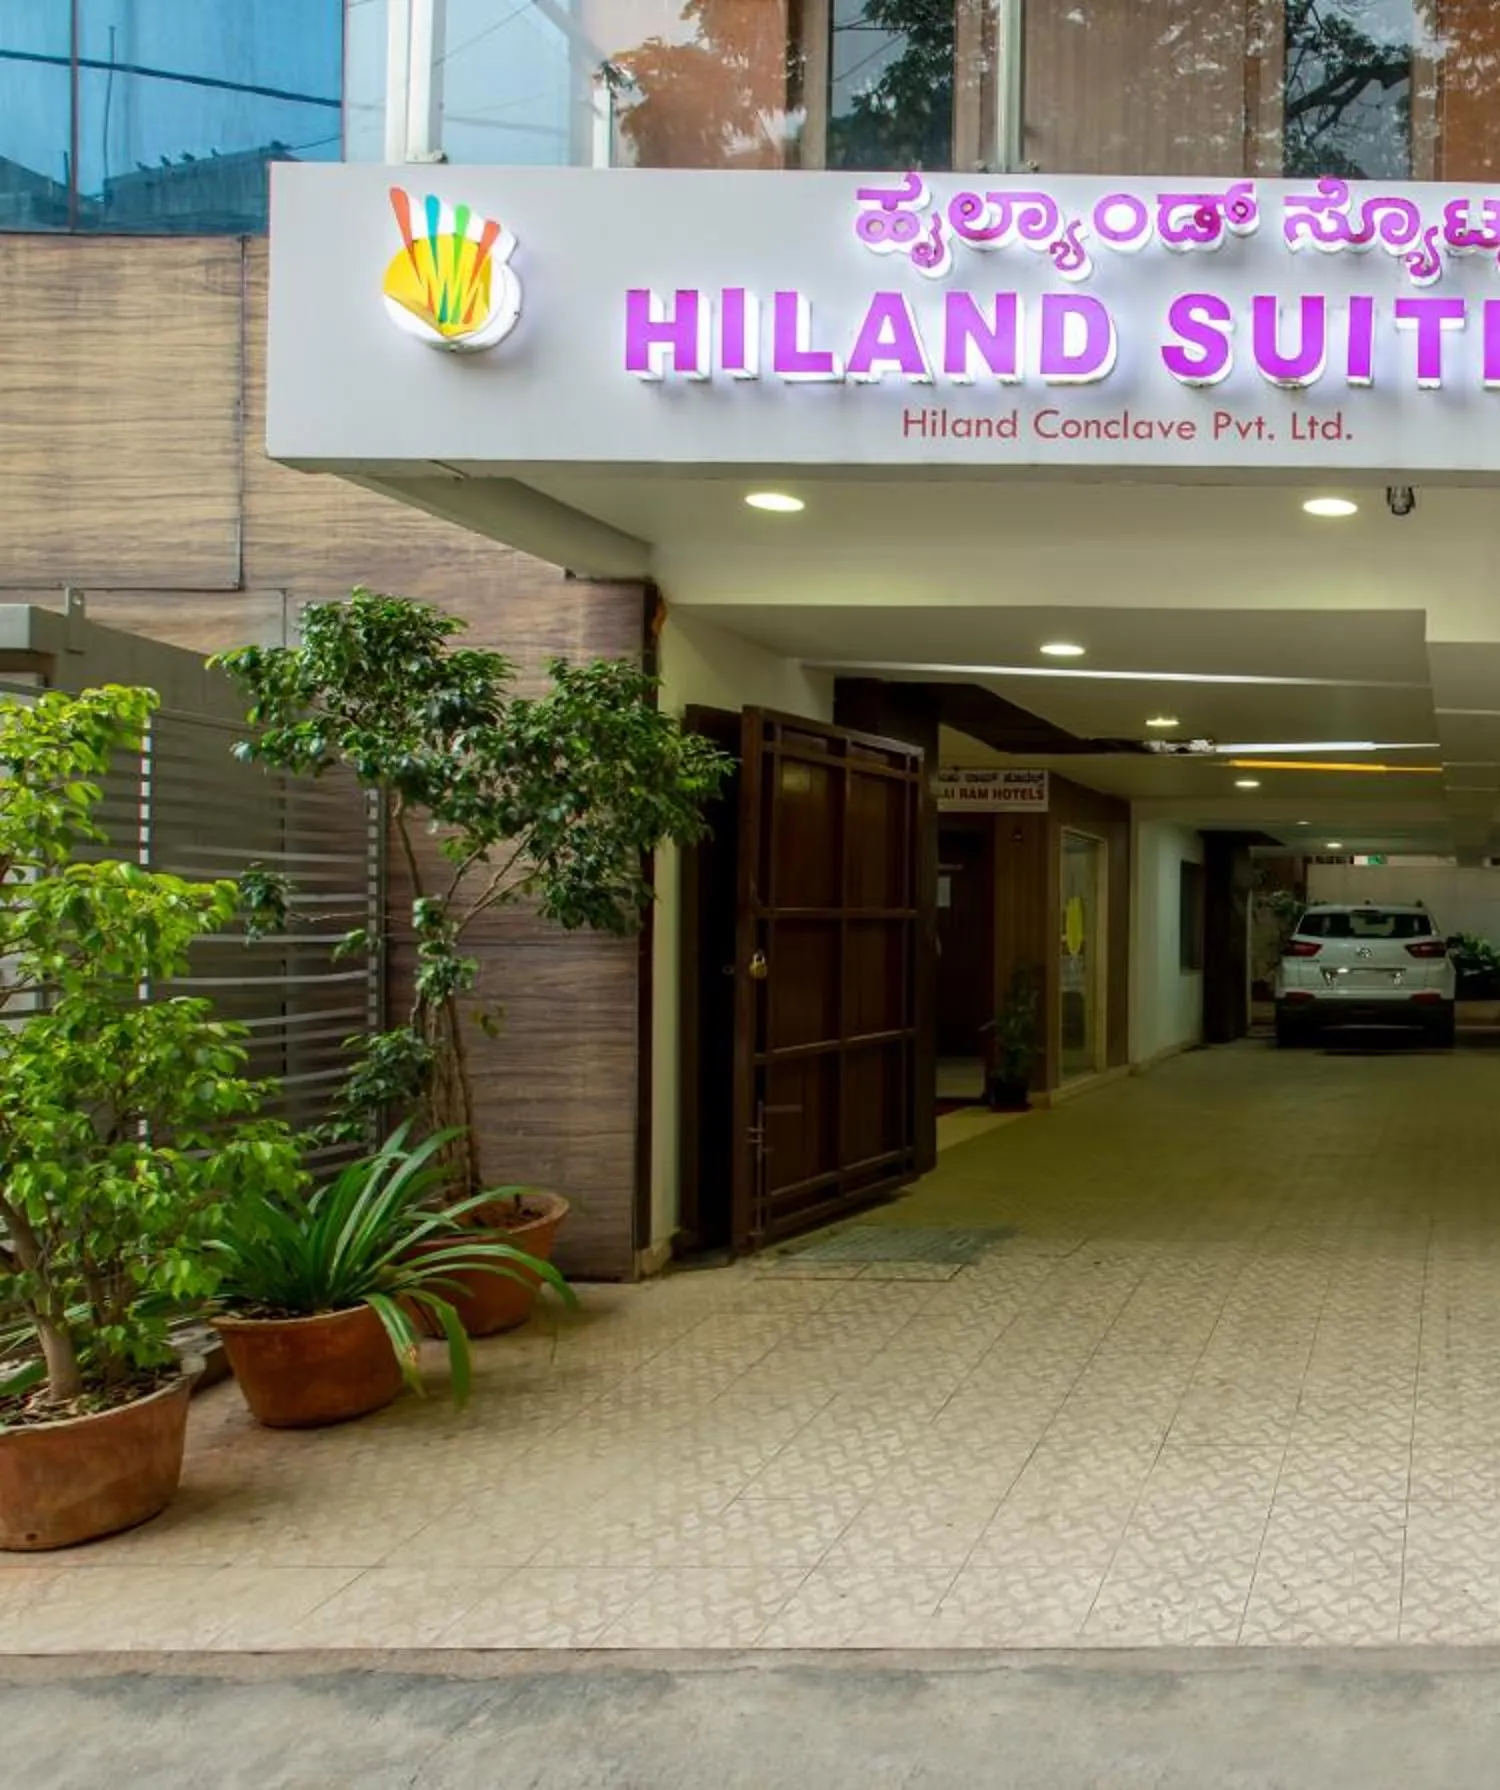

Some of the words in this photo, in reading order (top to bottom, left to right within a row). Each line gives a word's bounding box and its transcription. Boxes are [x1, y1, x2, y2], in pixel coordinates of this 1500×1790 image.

[625, 287, 1110, 375] HILAND
[902, 408, 1018, 440] Hiland
[1032, 408, 1197, 441] Conclave
[1213, 410, 1276, 441] Pvt.
[1291, 411, 1354, 442] Ltd.
[959, 787, 989, 800] RAM
[992, 787, 1045, 801] HOTELS
